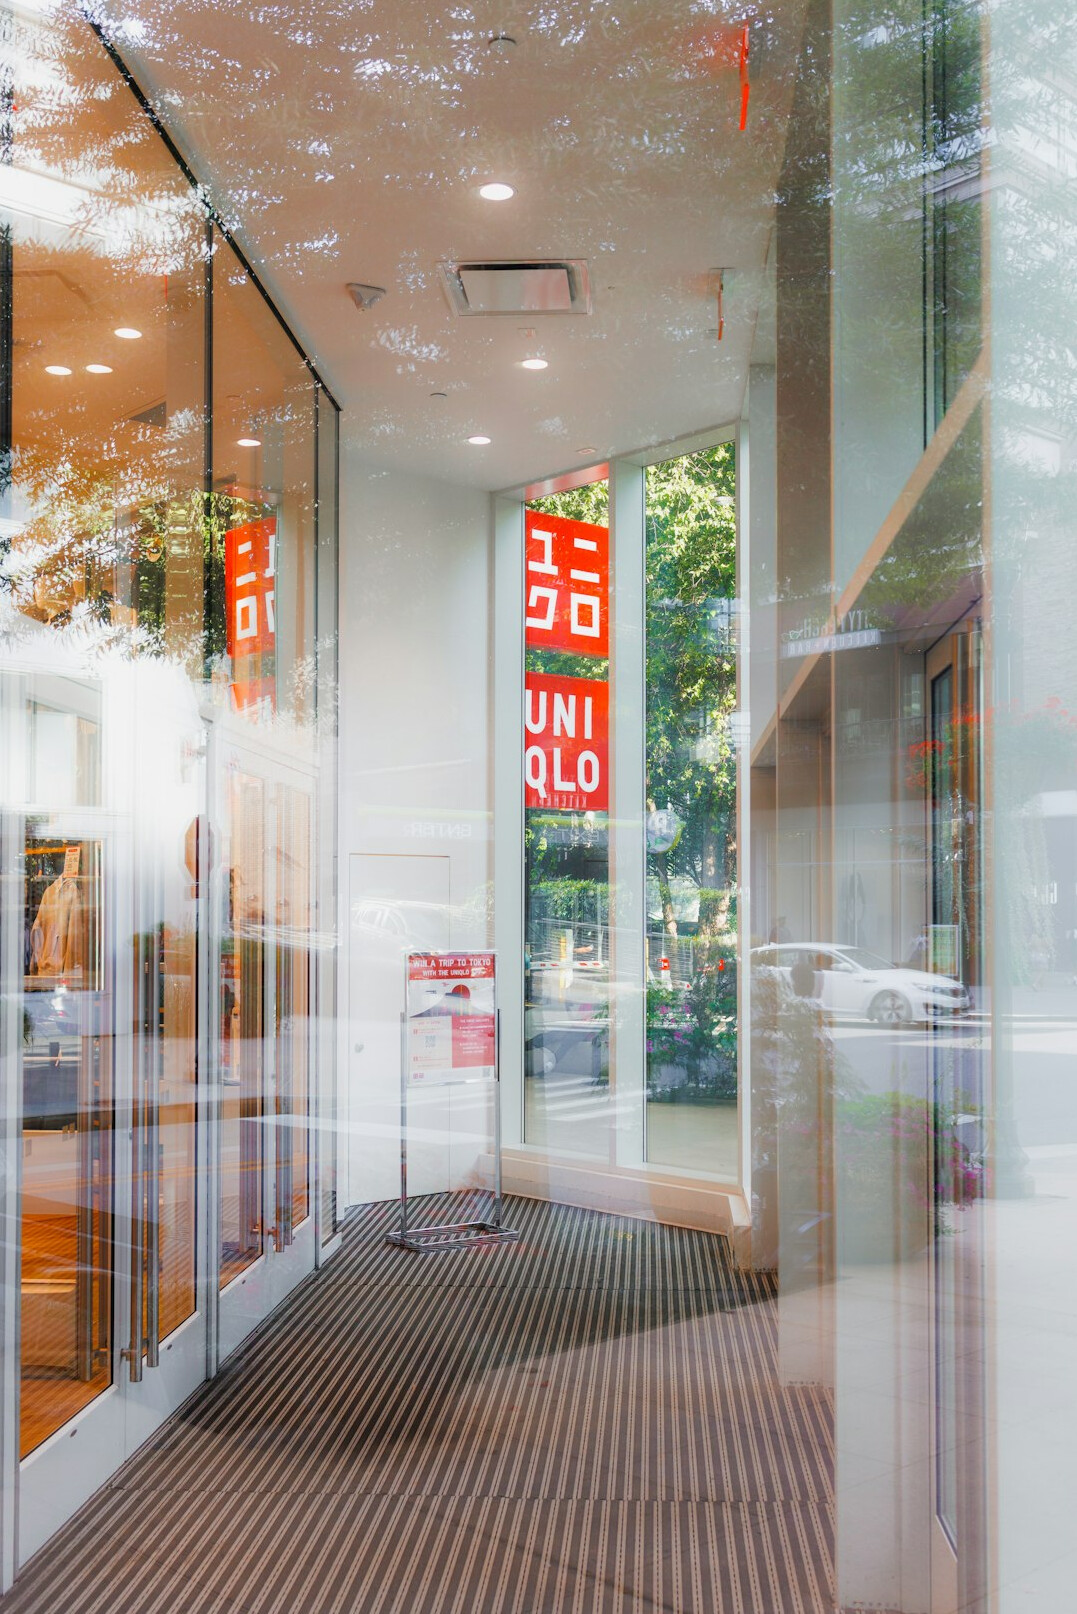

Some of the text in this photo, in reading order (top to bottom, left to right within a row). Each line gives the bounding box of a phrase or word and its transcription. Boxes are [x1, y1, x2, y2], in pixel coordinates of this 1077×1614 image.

[528, 528, 600, 583] ユニ
[526, 585, 600, 638] クロ
[525, 689, 592, 740] UNI
[525, 745, 600, 799] QLO
[439, 959, 454, 967] TRIP
[457, 958, 467, 967] TO
[470, 958, 491, 967] TOKYO
